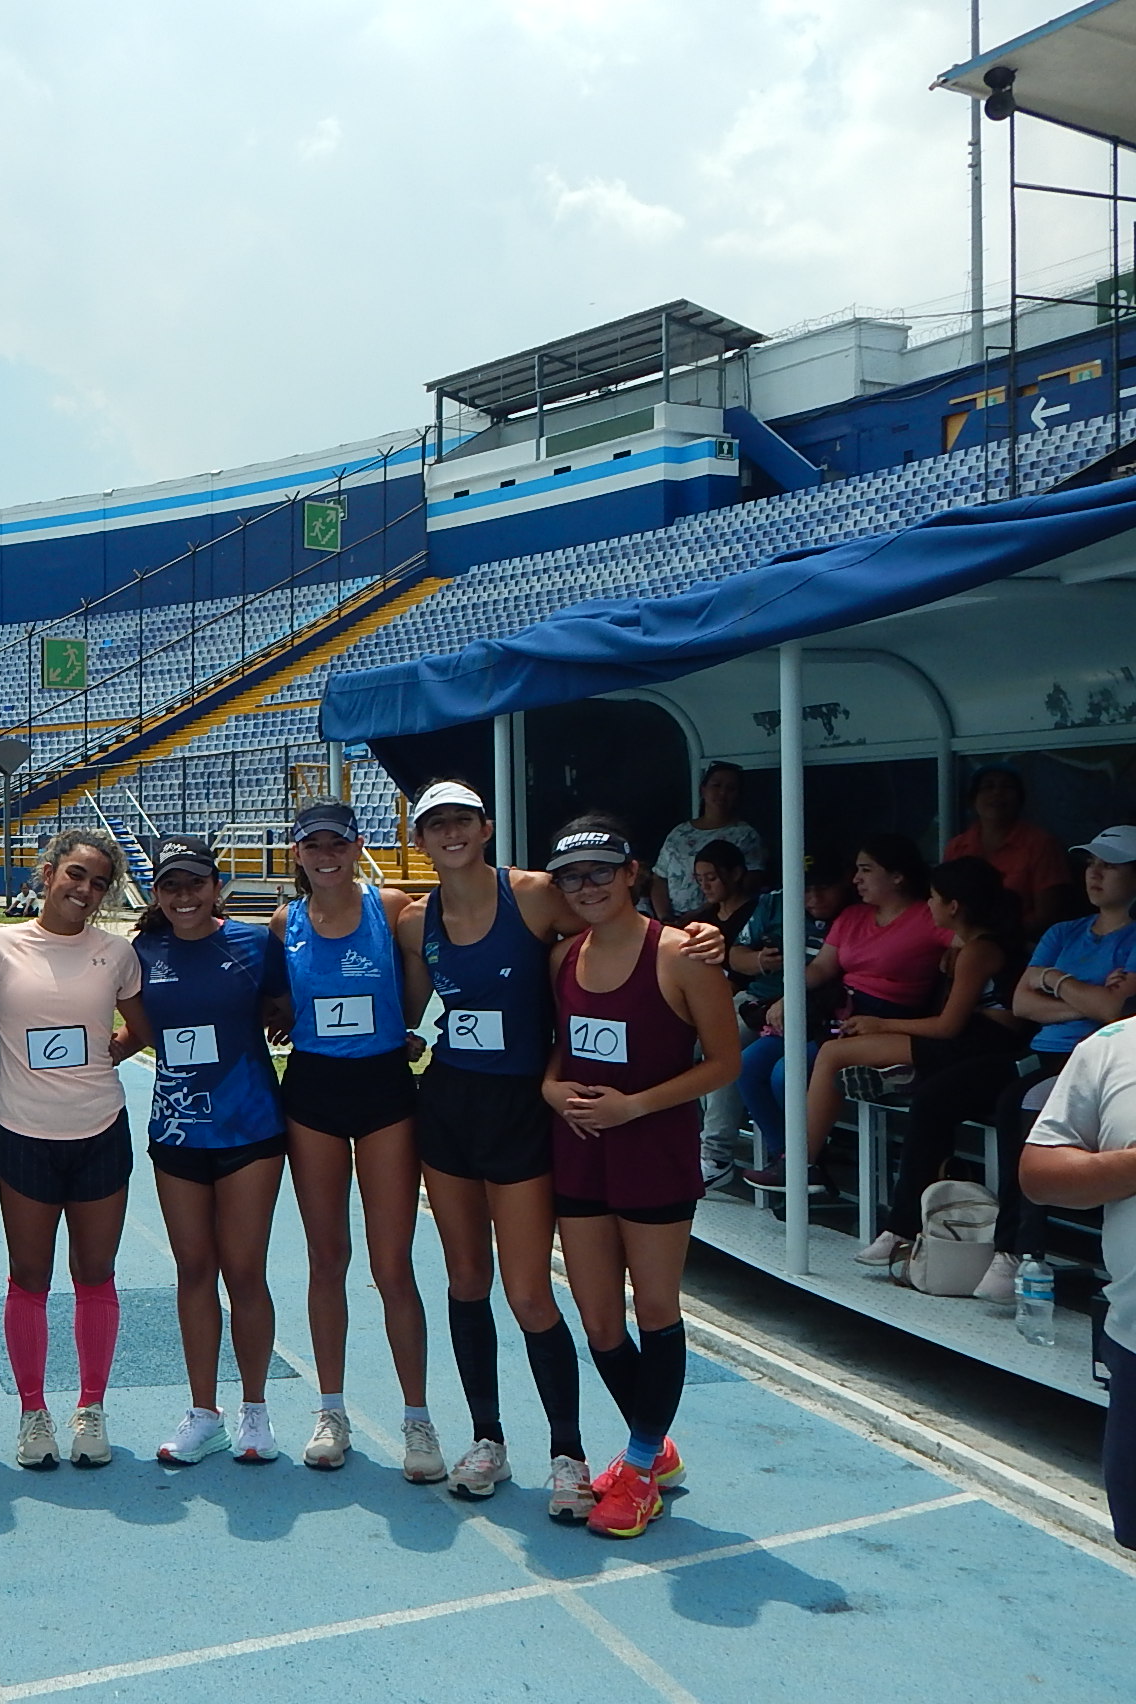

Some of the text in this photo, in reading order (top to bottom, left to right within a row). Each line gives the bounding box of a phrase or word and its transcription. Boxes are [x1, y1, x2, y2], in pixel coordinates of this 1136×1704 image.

[327, 1002, 359, 1027] 1
[177, 1030, 196, 1060] 9
[455, 1013, 484, 1048] 2
[573, 1023, 619, 1056] 10
[43, 1034, 69, 1061] 6
